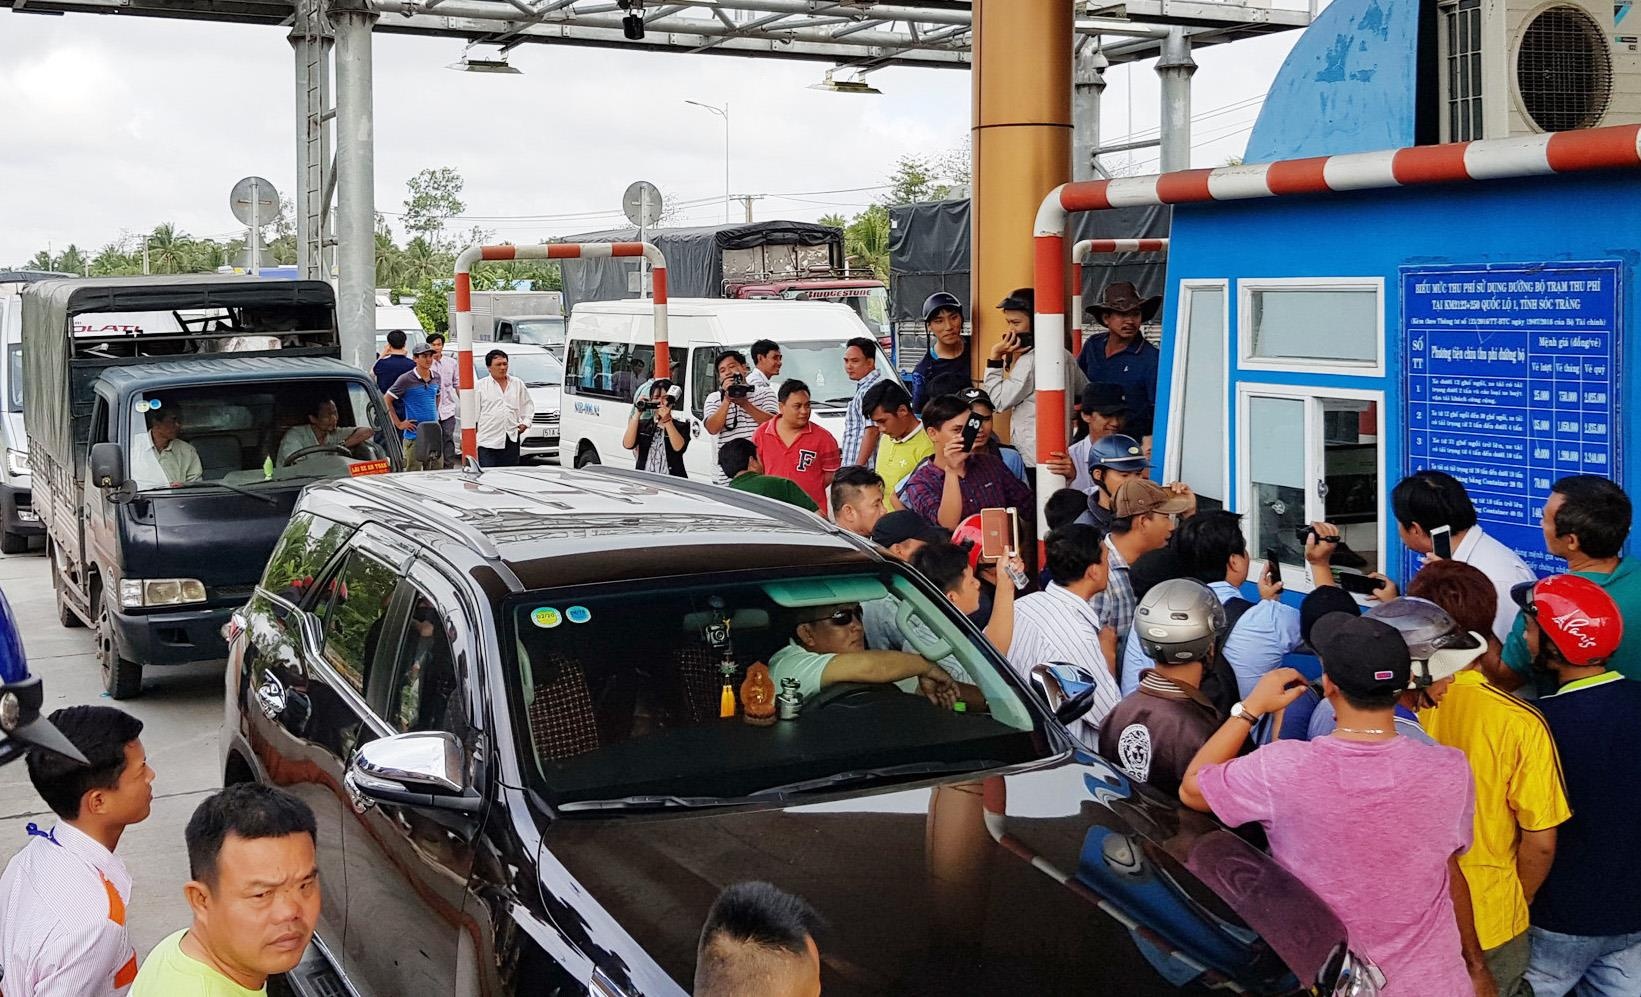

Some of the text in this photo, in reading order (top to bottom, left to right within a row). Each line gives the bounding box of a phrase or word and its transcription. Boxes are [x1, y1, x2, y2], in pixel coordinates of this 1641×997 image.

[1448, 282, 1462, 293] THU
[1463, 280, 1475, 293] PHÍ
[1487, 282, 1507, 294] DỤNG
[1535, 279, 1545, 294] BỘ
[1547, 281, 1567, 294] TRẠM
[1569, 280, 1585, 291] THU
[1586, 278, 1600, 291] PHÍ
[1481, 295, 1501, 311] QUỐC
[1502, 297, 1511, 312] LỘ
[1539, 296, 1553, 310] SÓC
[1555, 297, 1581, 310] TRĂNG
[1412, 335, 1424, 351] SỐ
[1412, 358, 1424, 368] TT
[1416, 411, 1422, 419] 2
[796, 449, 816, 471] F
